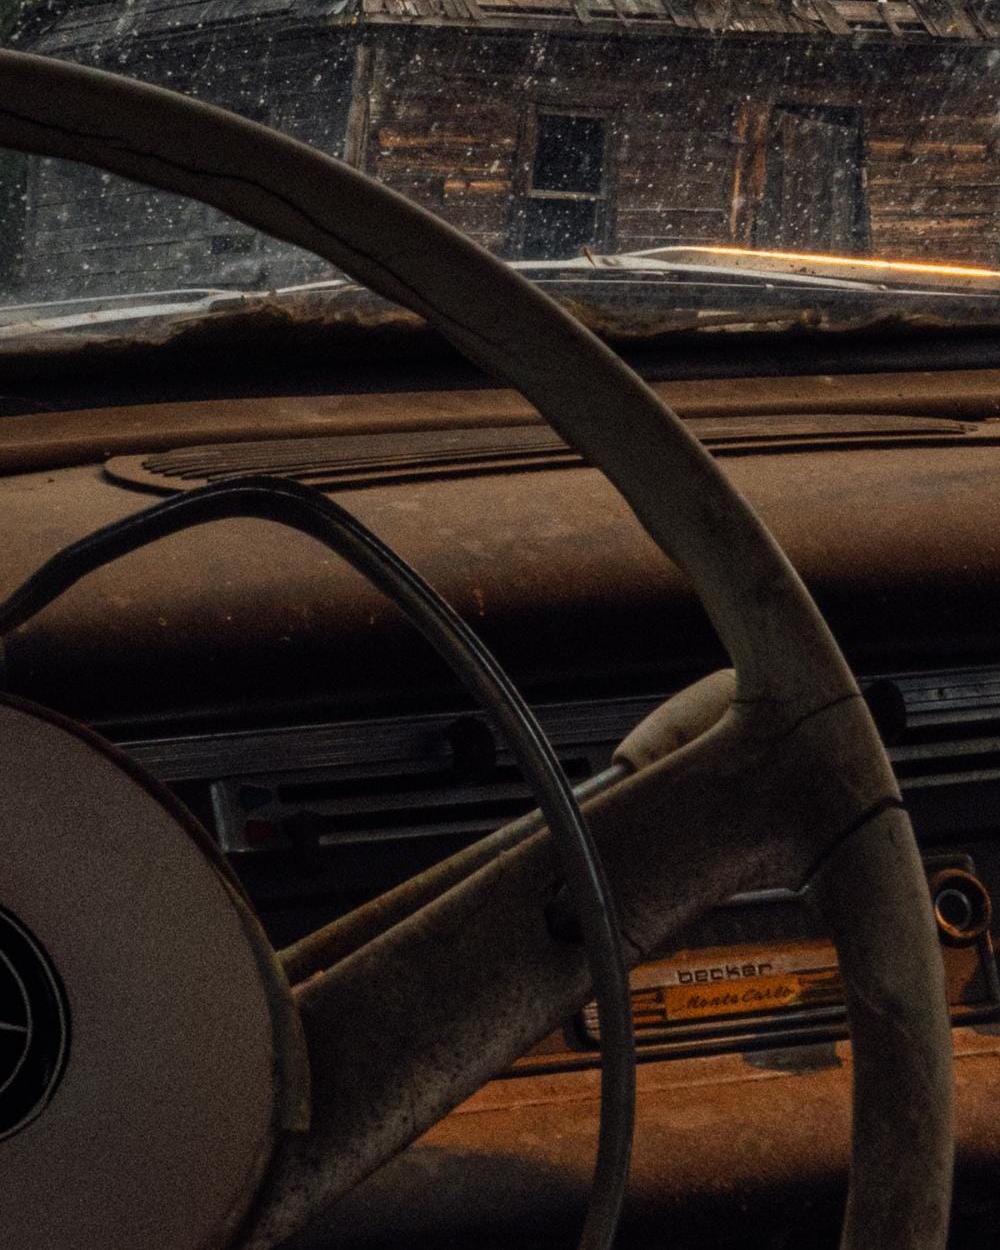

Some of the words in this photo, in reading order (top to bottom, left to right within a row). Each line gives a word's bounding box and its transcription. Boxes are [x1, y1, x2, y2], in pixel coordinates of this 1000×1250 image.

[677, 963, 772, 984] becker
[673, 992, 739, 1011] Monte
[741, 986, 794, 1003] Carlo
